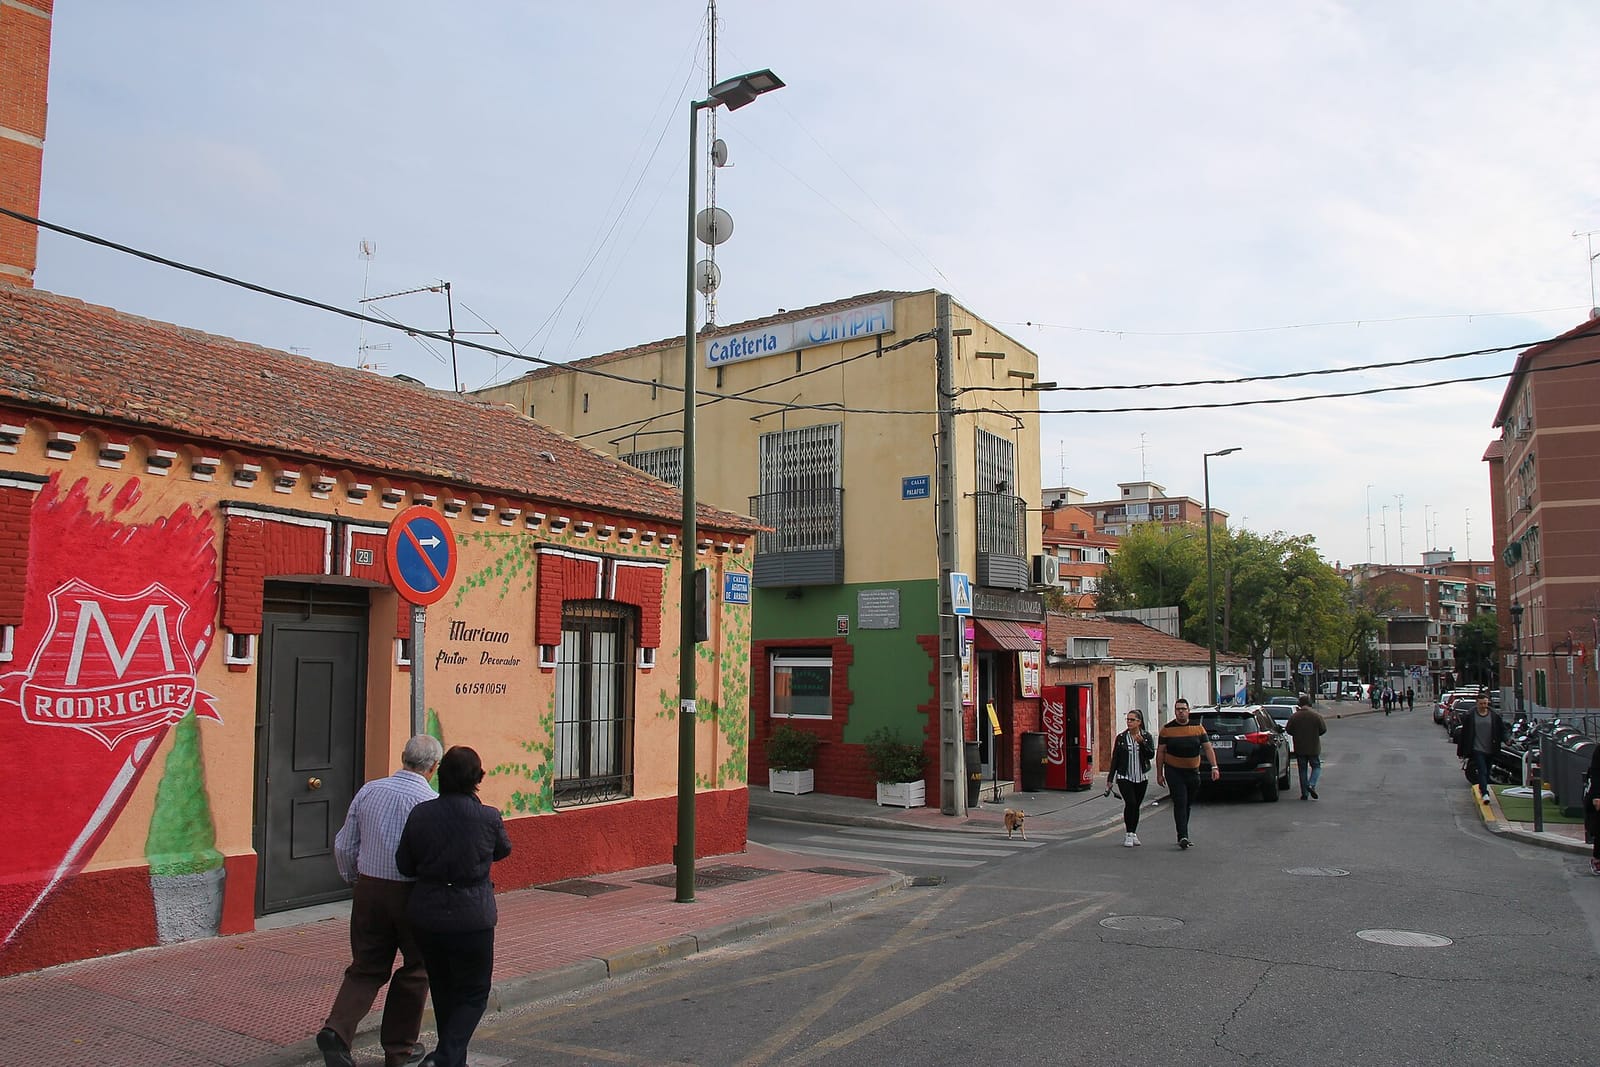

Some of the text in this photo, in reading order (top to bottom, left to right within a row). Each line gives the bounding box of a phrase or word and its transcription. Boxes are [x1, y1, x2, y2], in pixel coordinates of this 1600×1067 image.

[709, 334, 777, 362] Cafeteria
[358, 551, 369, 563] 29
[732, 576, 747, 584] CALLE
[725, 591, 732, 600] DE
[449, 620, 510, 644] Mariano
[65, 600, 176, 686] M
[480, 650, 521, 666] Decorador
[455, 682, 507, 695] 661590054
[35, 684, 192, 719] RODRIGUEZ
